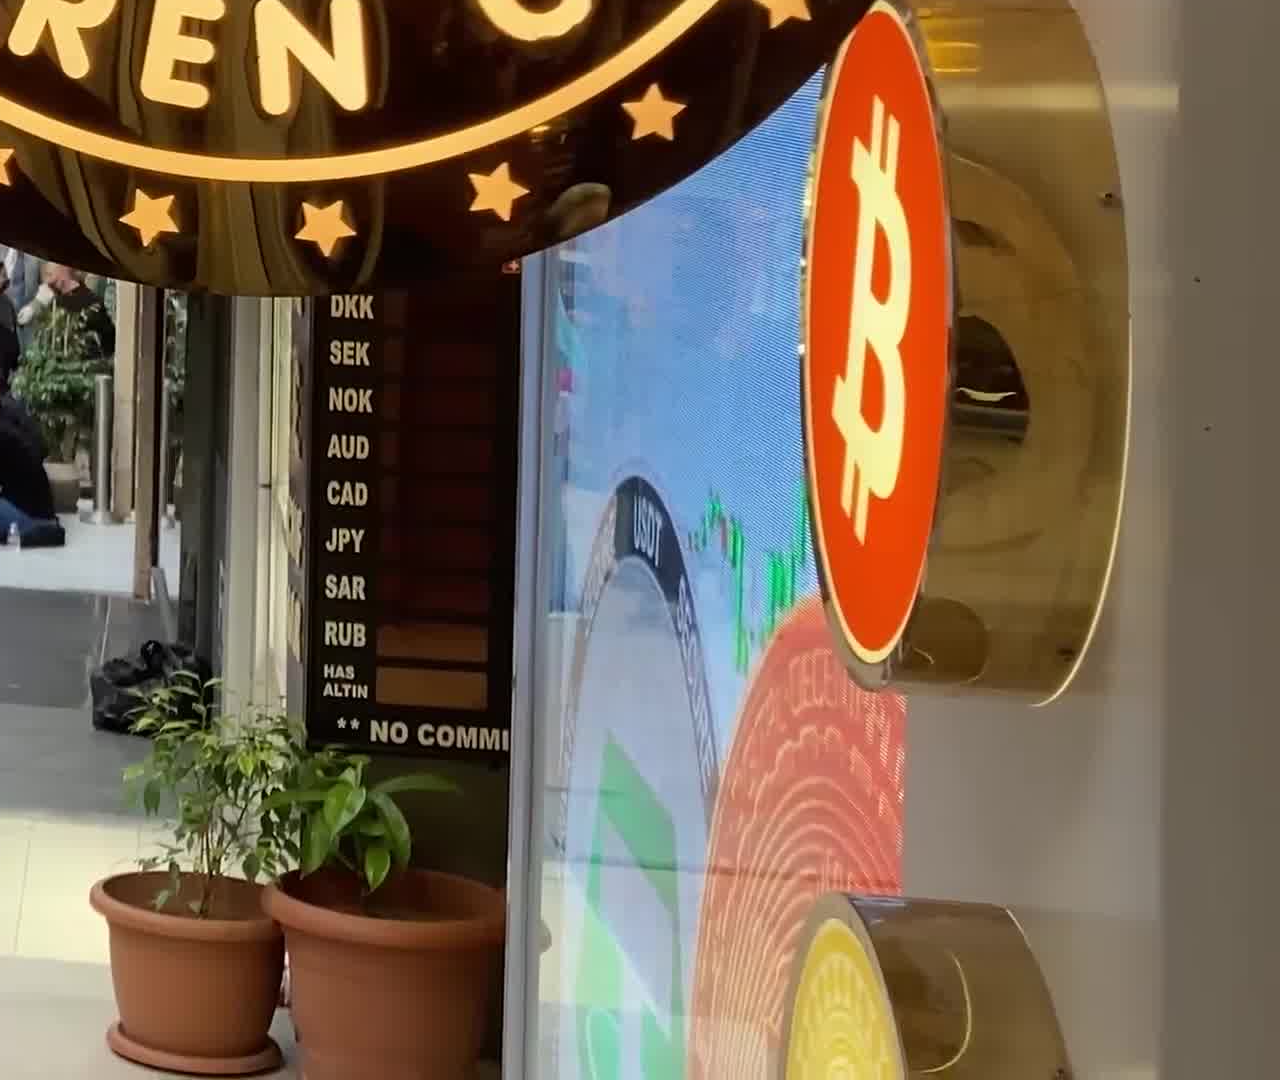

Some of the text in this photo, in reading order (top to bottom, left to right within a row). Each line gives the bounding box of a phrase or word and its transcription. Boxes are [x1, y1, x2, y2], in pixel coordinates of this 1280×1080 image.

[330, 294, 374, 319] DKK
[329, 340, 370, 366] SEK
[329, 386, 373, 413] NOK
[327, 434, 370, 460] AUD
[327, 480, 368, 507] CAD
[325, 527, 365, 553] JPY
[633, 493, 662, 568] USDT
[325, 574, 366, 601] SAR
[324, 621, 367, 648] RUB
[323, 664, 355, 680] HAS
[323, 683, 368, 699] ALTIN
[370, 720, 409, 745] NO
